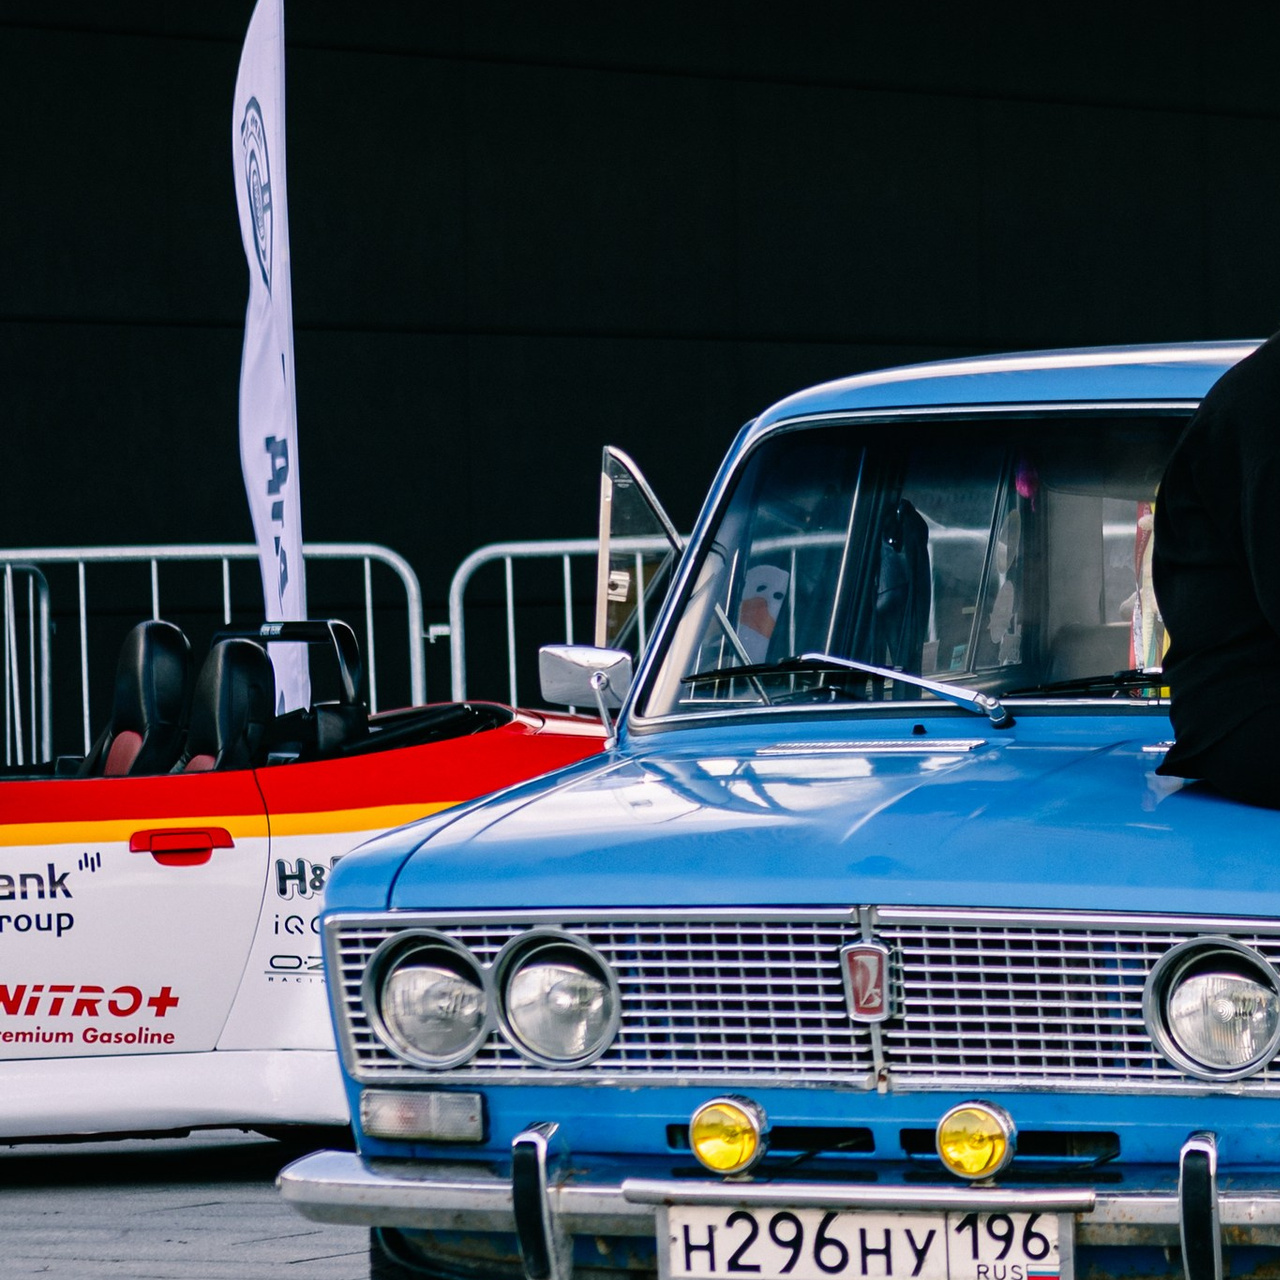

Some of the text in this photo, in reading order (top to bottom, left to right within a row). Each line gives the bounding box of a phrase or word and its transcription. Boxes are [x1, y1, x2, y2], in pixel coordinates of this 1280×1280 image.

[276, 856, 344, 900] H&
[0, 1026, 175, 1044] emium Gasoline
[955, 1213, 1051, 1260] 196
